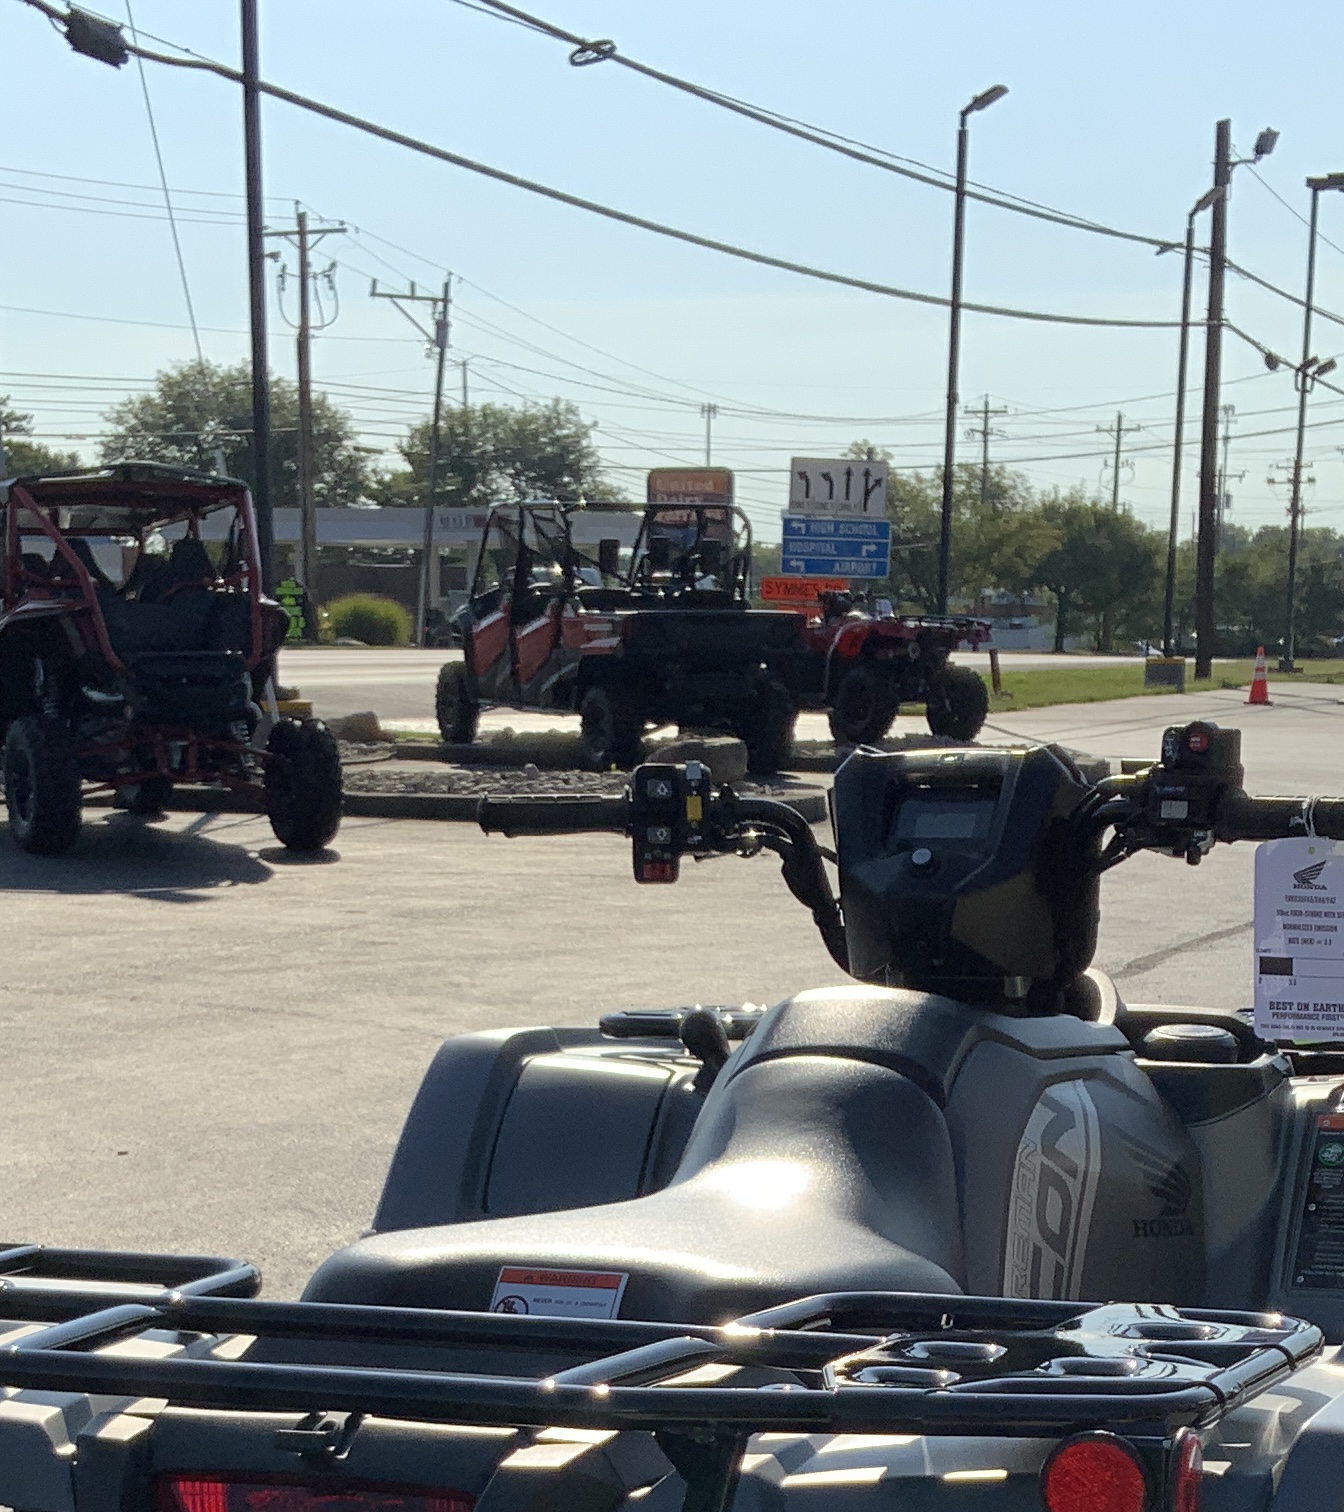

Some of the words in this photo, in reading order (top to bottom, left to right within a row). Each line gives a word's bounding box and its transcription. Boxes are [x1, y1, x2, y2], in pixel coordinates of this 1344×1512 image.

[810, 522, 834, 533] HIGH
[839, 523, 878, 536] SCHOOL
[789, 541, 837, 554] HOSPITAL
[833, 562, 877, 575] AIRPORT
[765, 581, 819, 596] SYMMES
[1269, 1001, 1294, 1011] BEST
[1297, 1002, 1310, 1011] ON
[1272, 1013, 1320, 1021] PERFORMANCE
[1133, 1218, 1193, 1237] HONDA
[539, 1275, 597, 1284] WARNING
